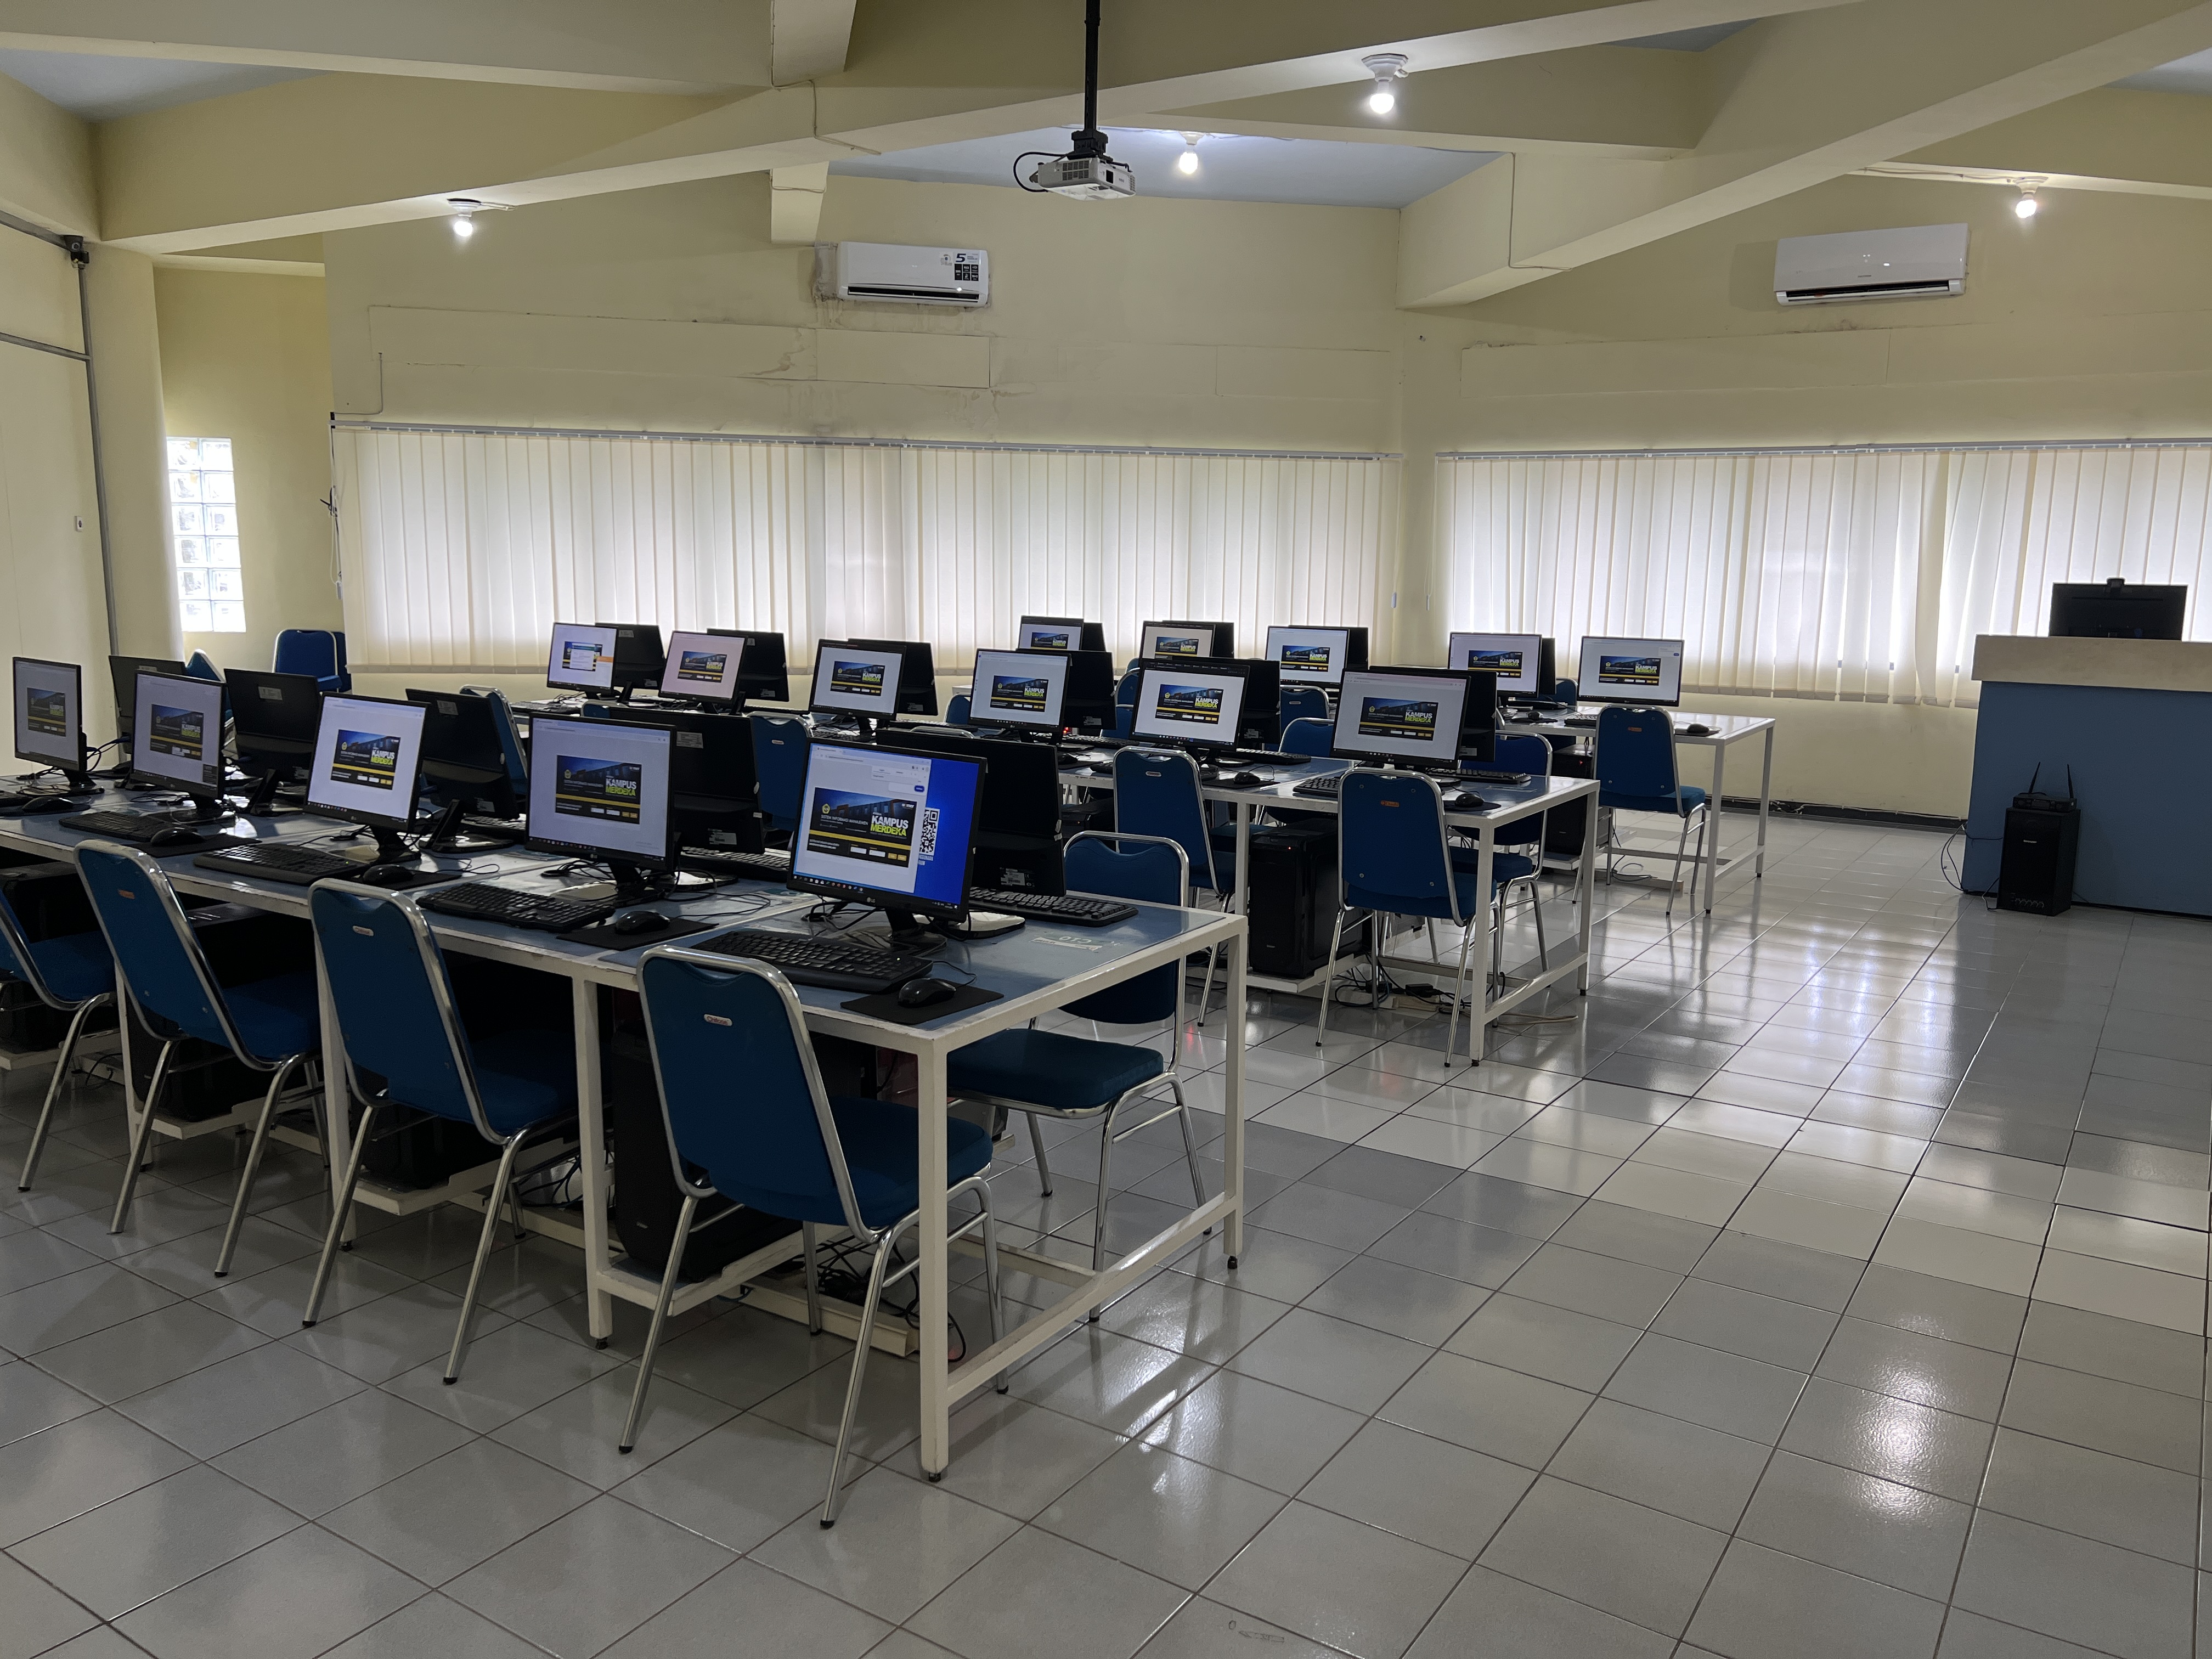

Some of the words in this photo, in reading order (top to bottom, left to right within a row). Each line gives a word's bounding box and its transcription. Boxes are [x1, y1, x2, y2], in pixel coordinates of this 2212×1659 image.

[956, 253, 966, 262] 5
[606, 778, 637, 789] KAMPUS
[871, 815, 909, 829] KAMPUS
[870, 824, 906, 836] MERDEKA
